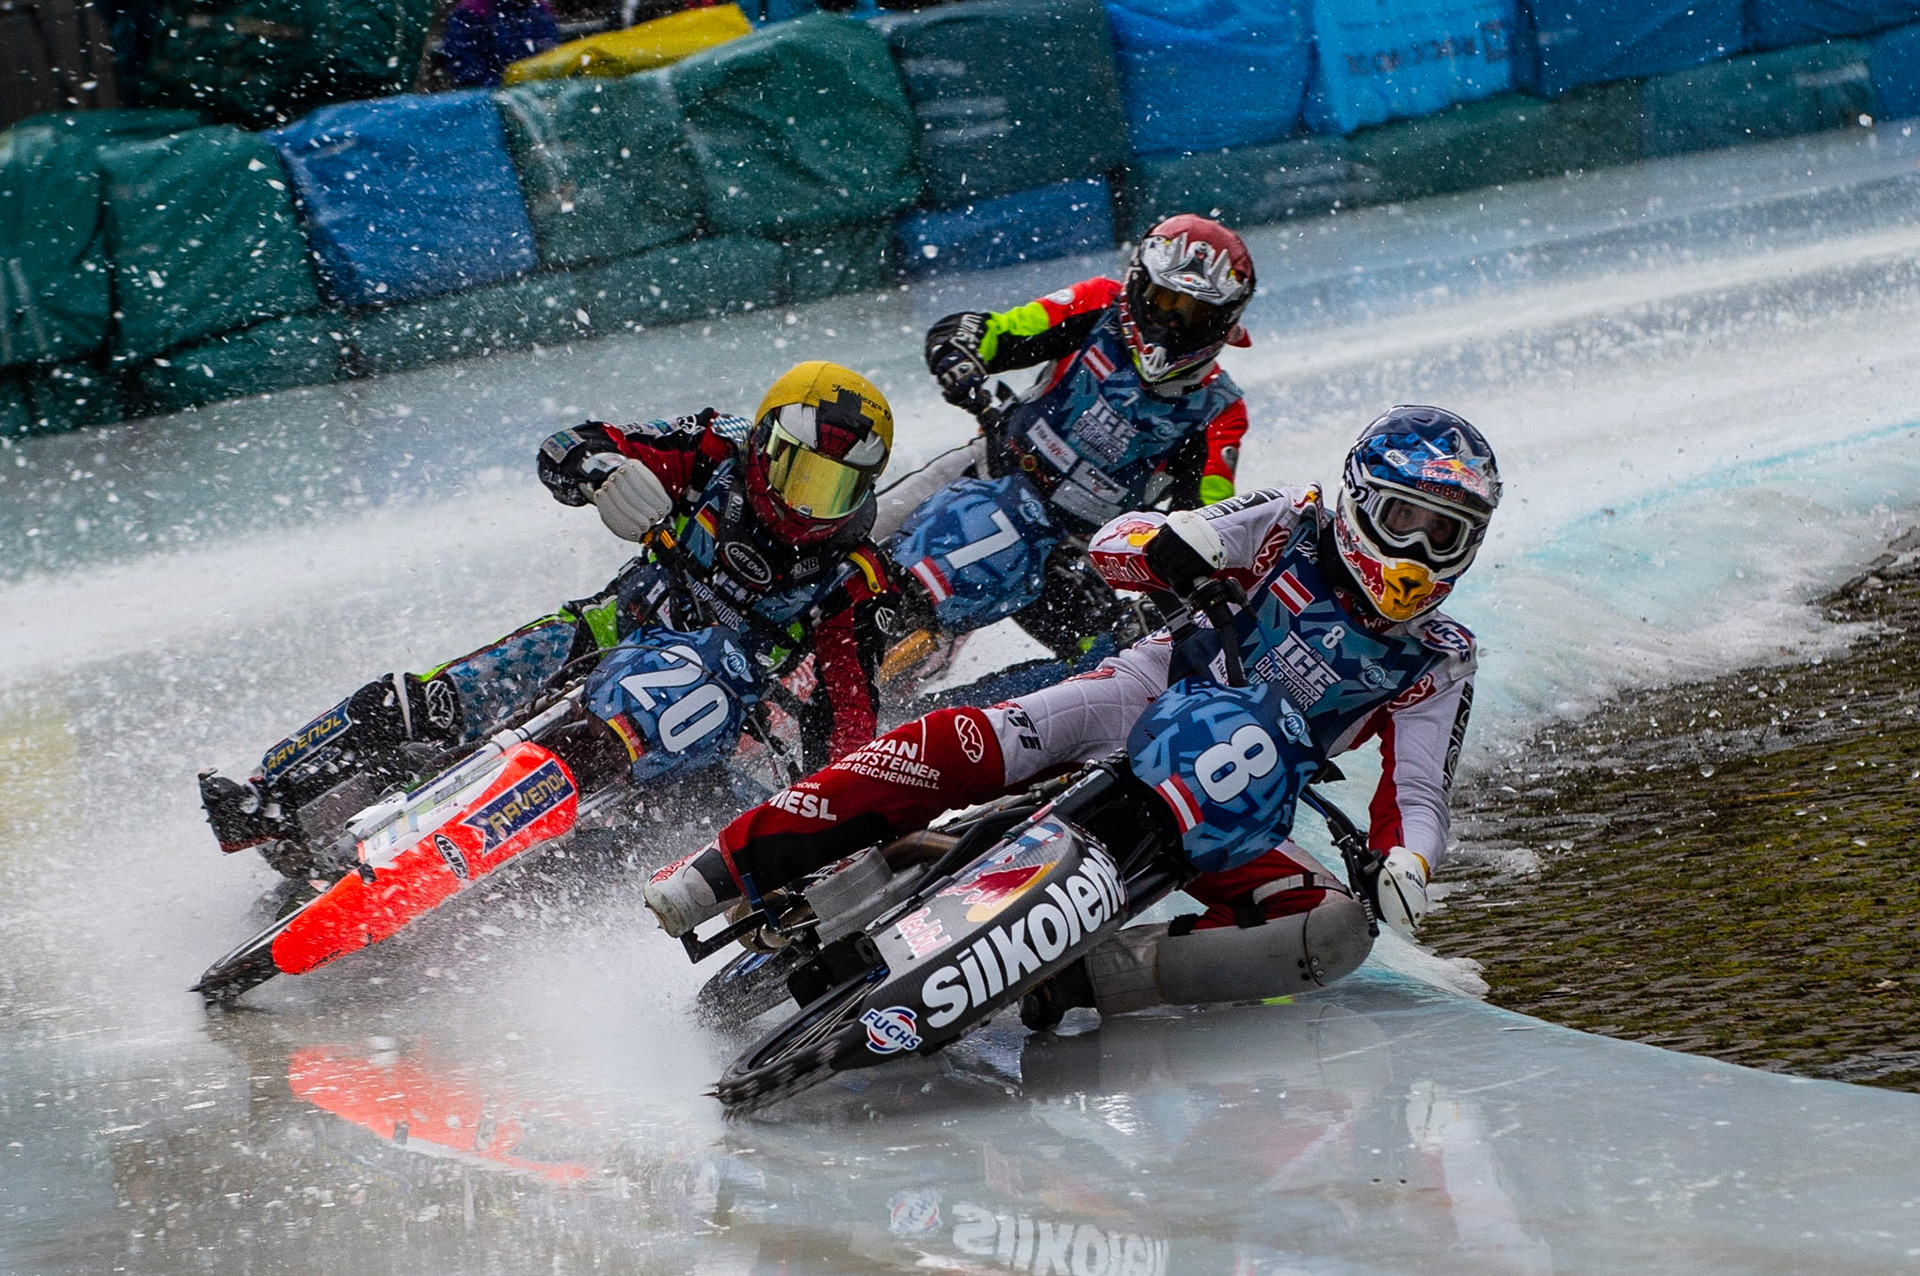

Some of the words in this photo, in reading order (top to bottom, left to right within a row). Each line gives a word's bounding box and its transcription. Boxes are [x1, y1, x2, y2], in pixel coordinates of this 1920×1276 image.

[1442, 485, 1466, 503] Bull
[730, 548, 767, 578] ORTEMA
[1321, 625, 1346, 650] 8
[1419, 619, 1471, 663] FUCHS
[728, 654, 743, 673] FIM
[1268, 650, 1320, 700] PEEDWAY
[1272, 633, 1338, 695] ICE
[618, 645, 730, 752] 20
[266, 715, 343, 771] RAVENOL
[1286, 716, 1303, 738] FIM
[850, 764, 940, 791] REICHENHALL
[1194, 724, 1278, 804] 8
[488, 773, 566, 832] RAVENOL
[921, 846, 1126, 1029] Silkolene
[862, 1010, 923, 1051] FUCHS
